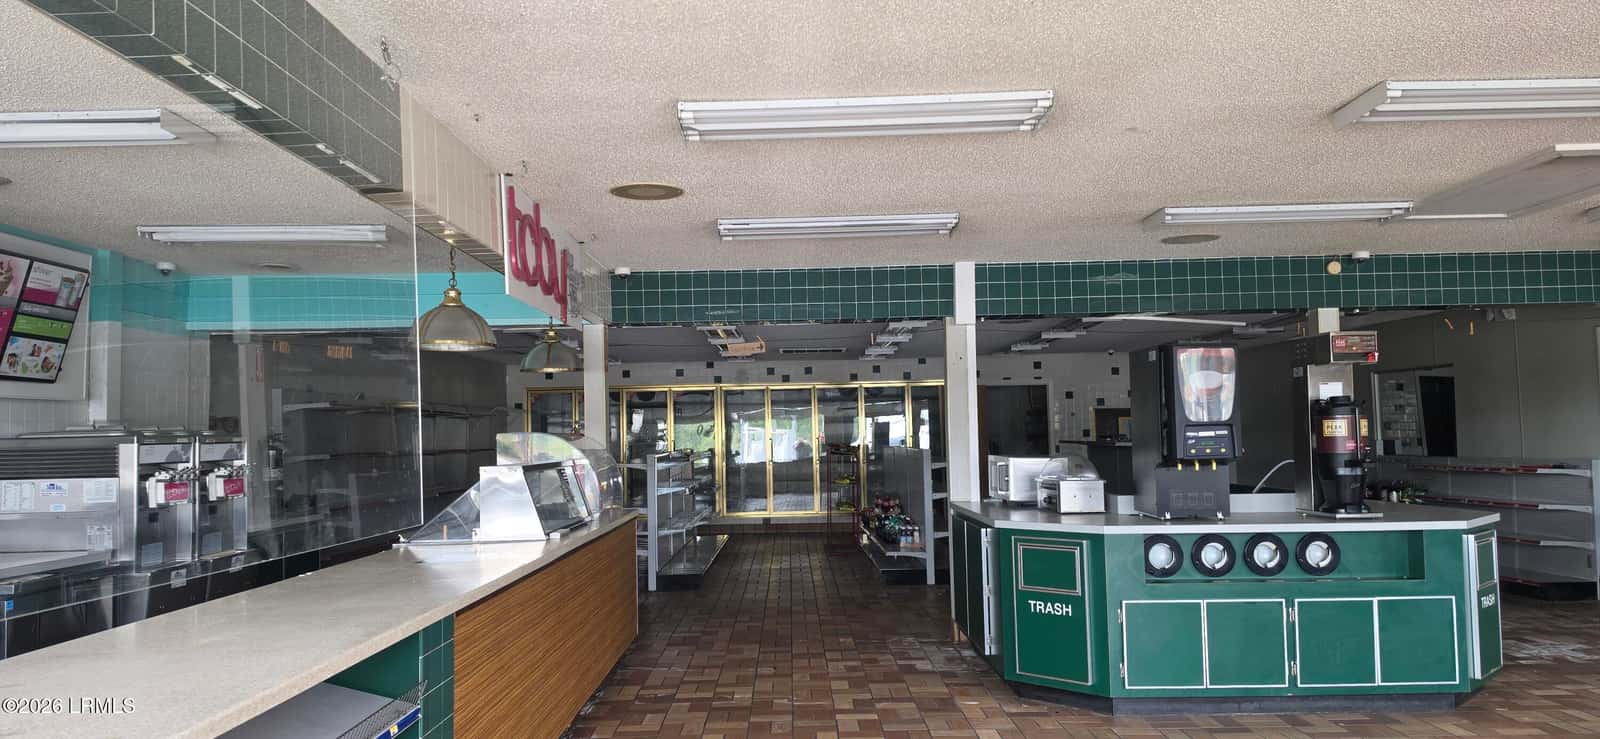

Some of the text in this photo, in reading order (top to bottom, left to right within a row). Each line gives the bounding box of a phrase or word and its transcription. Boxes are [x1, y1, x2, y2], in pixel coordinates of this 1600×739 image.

[507, 186, 569, 325] tcby
[1028, 600, 1072, 617] TRASH
[1481, 593, 1495, 608] TRASH
